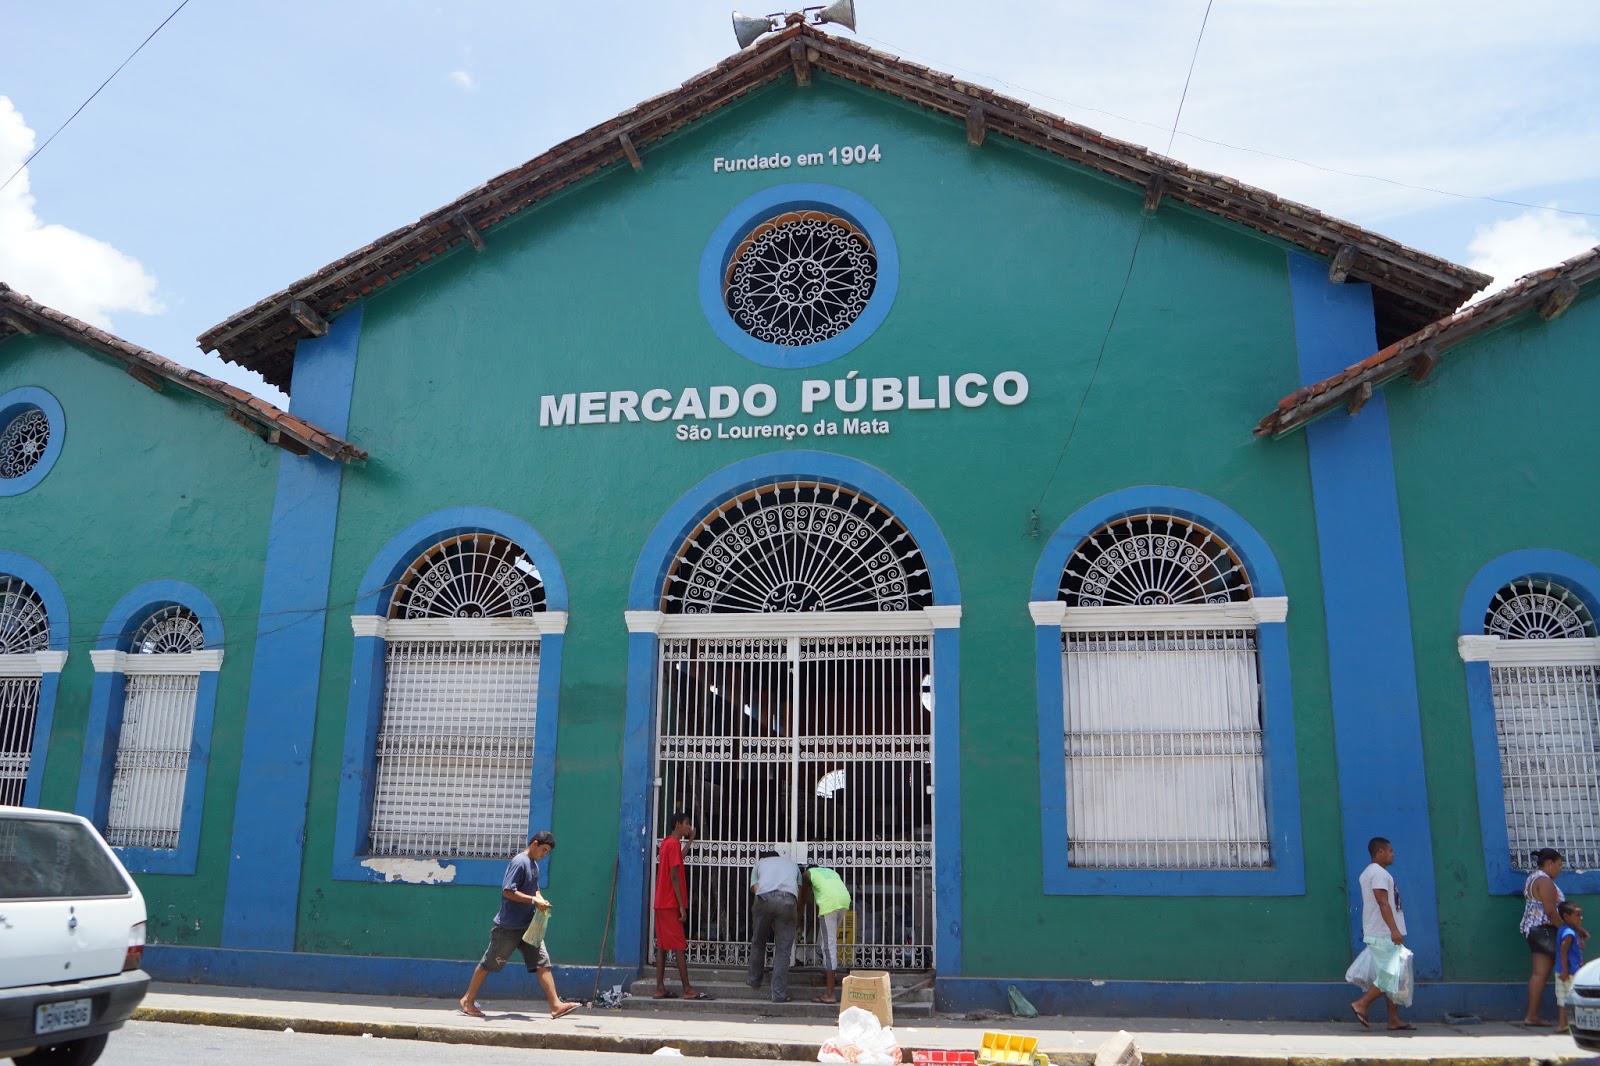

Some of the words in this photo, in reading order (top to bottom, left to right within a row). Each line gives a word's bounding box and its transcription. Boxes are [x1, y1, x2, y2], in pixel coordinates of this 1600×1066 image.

[713, 152, 792, 173] Fundado
[797, 153, 824, 167] em
[828, 143, 882, 166] 1904
[539, 383, 778, 427] MERCADO
[801, 370, 1030, 413] PÚBLICO
[675, 424, 713, 441] São
[717, 422, 809, 441] Lourenço
[813, 419, 839, 436] da
[843, 418, 891, 435] Mata
